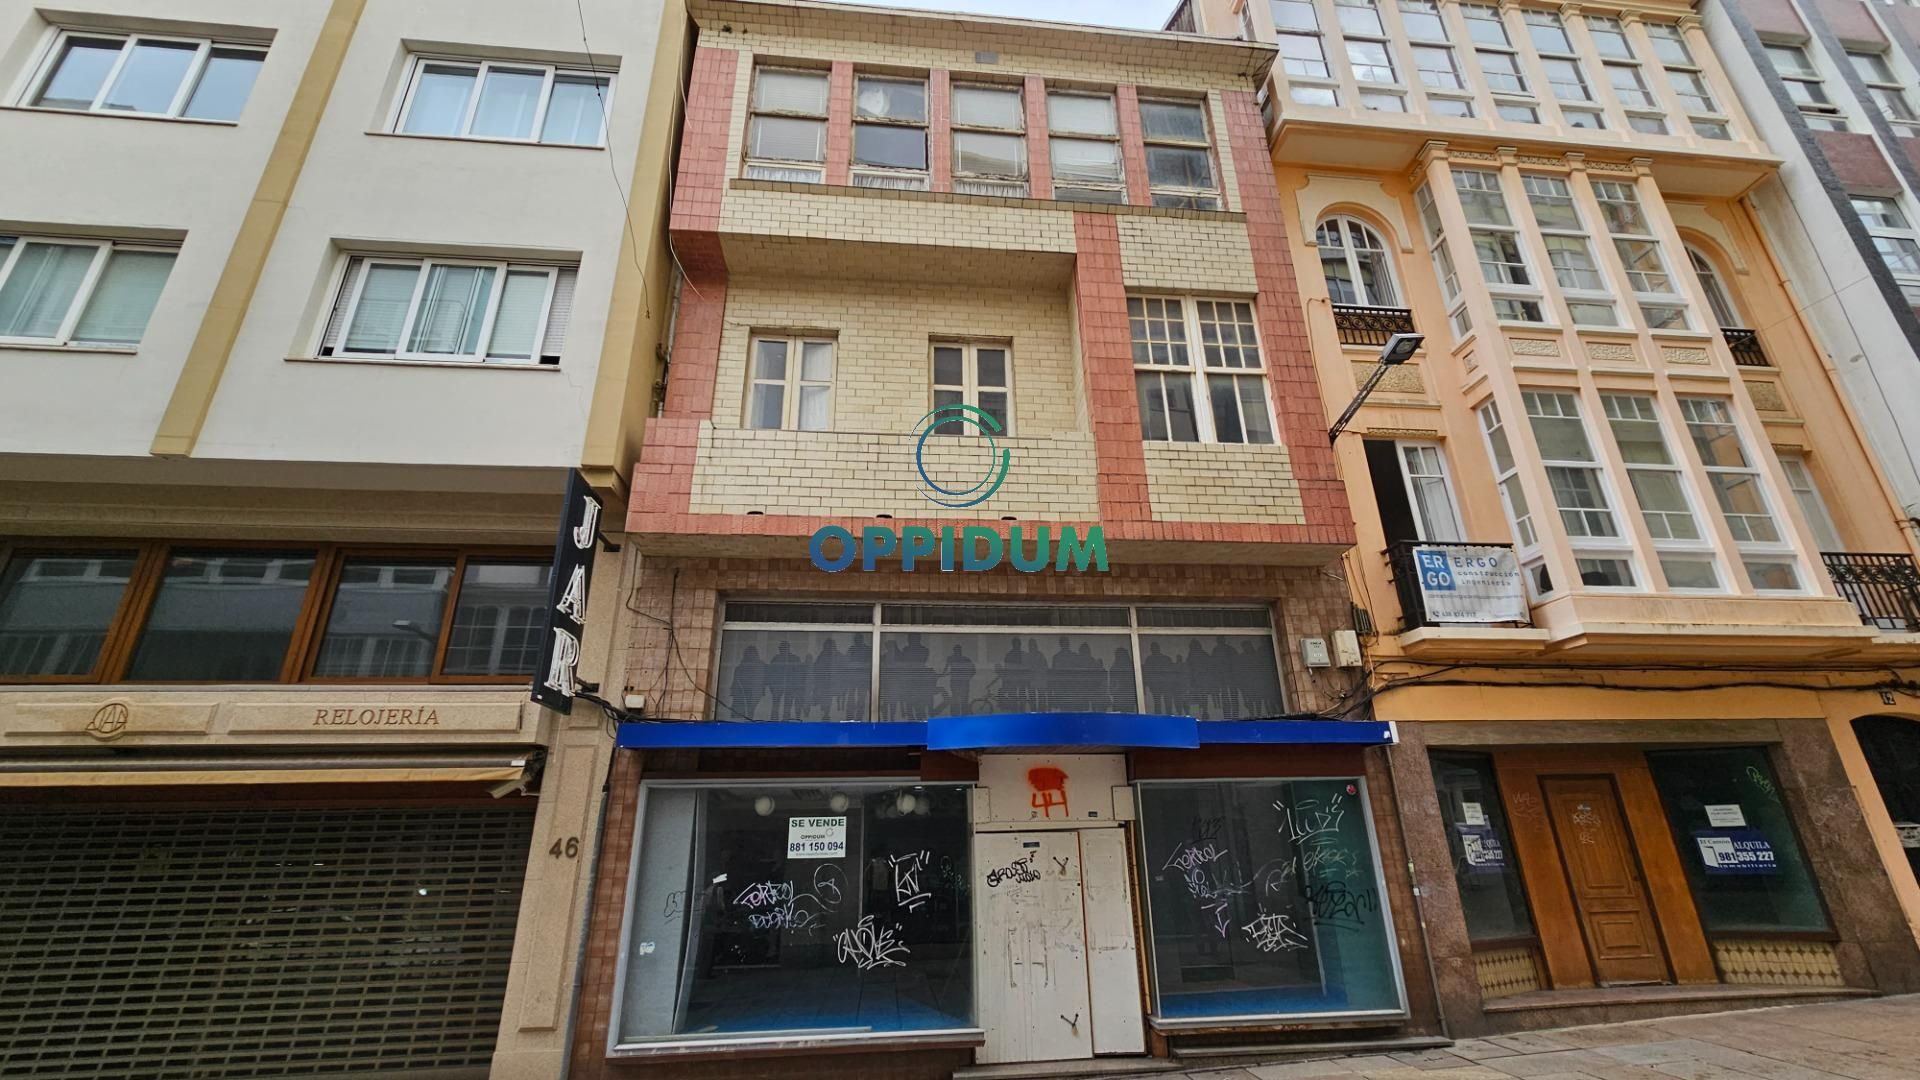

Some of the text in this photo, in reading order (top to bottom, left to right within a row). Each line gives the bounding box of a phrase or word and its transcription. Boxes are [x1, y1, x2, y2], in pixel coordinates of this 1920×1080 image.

[1422, 555, 1445, 568] ER
[1454, 557, 1498, 568] ERGO
[1427, 571, 1450, 586] GO
[544, 496, 601, 697] JAR
[313, 706, 439, 726] RELOJERÍA
[791, 818, 845, 828] SE VENDE
[549, 837, 579, 860] 46
[789, 841, 844, 852] 881 150 094
[1733, 841, 1771, 850] ALQUILA
[1718, 851, 1774, 862] 981 355 227
